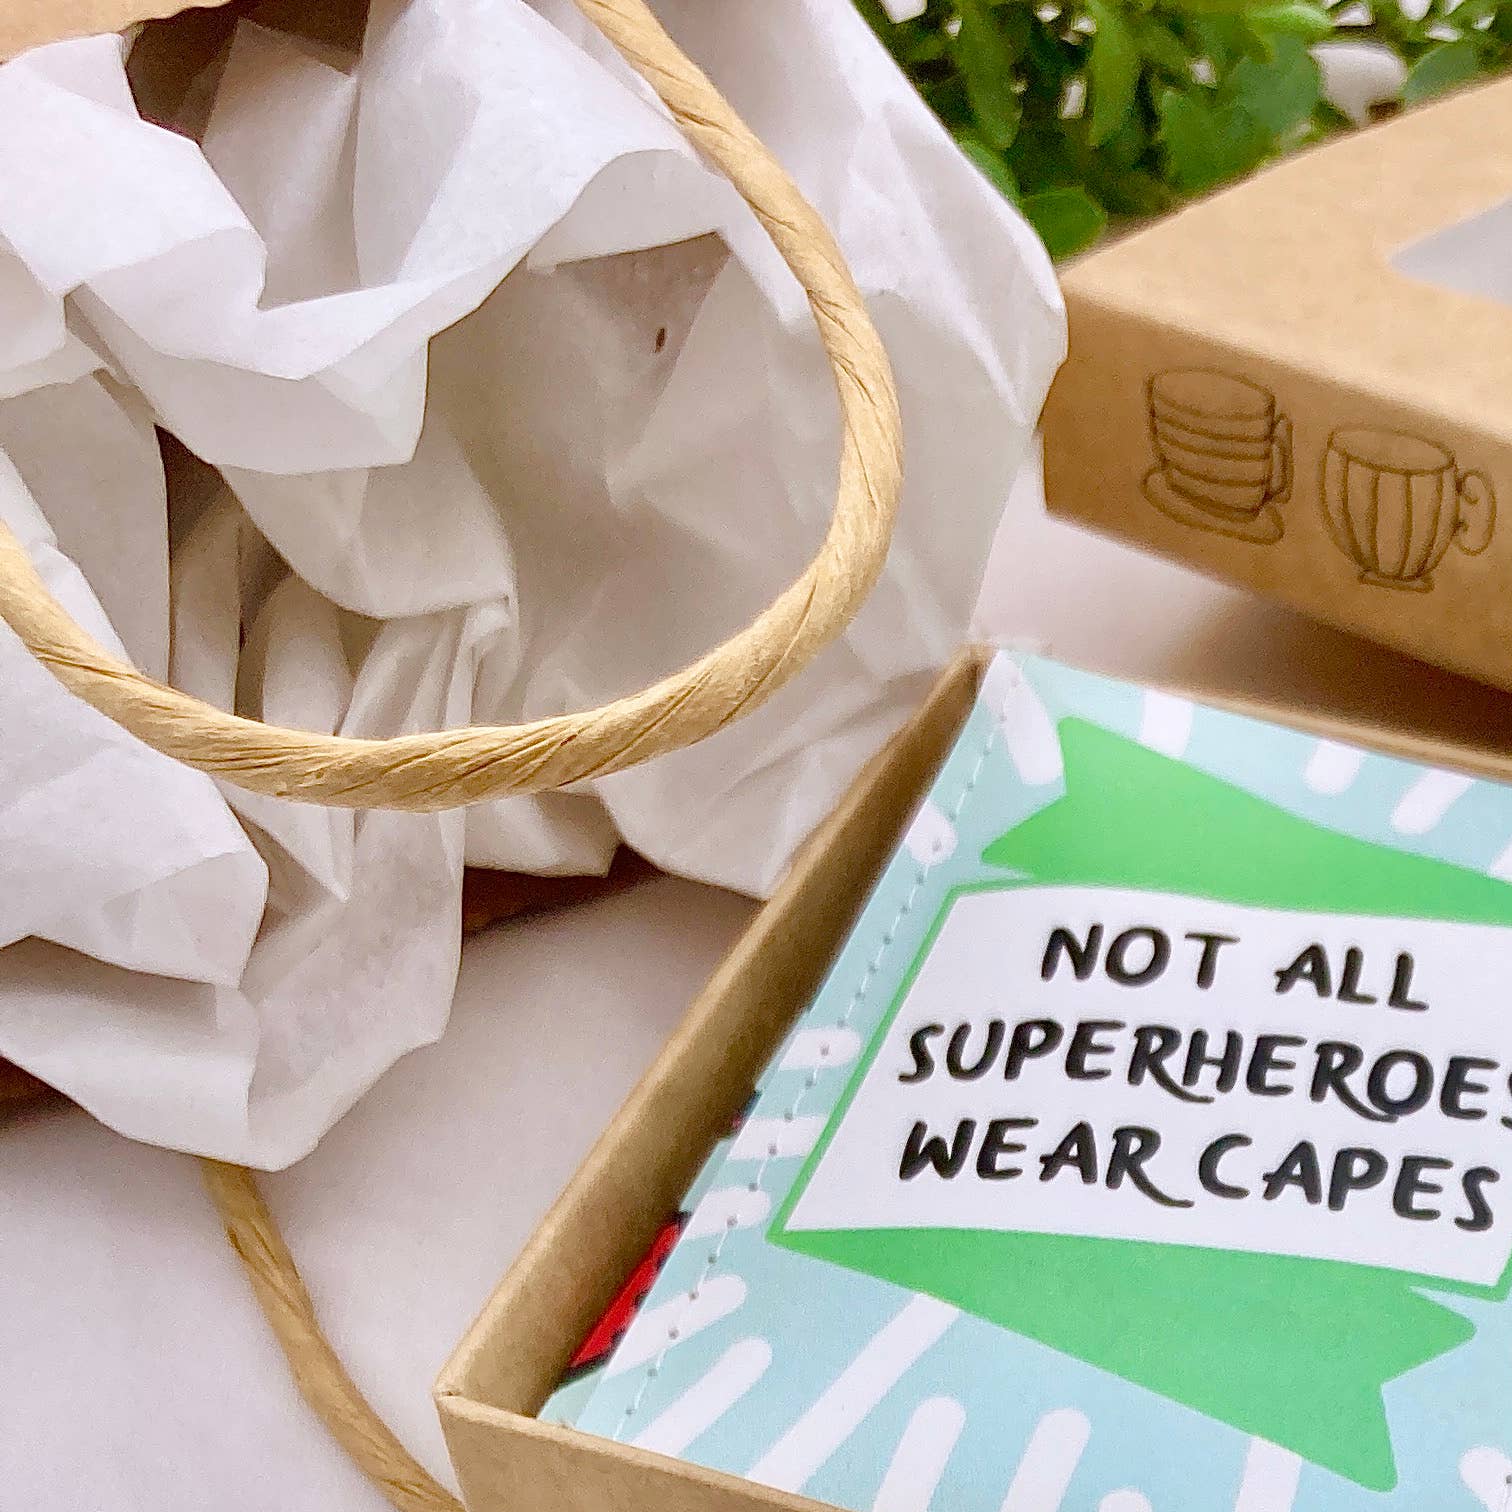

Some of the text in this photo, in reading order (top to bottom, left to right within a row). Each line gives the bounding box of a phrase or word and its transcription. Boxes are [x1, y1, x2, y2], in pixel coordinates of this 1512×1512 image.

[1040, 922, 1430, 1012] NOT ALL
[897, 1117, 1501, 1233] WEAR CAPES
